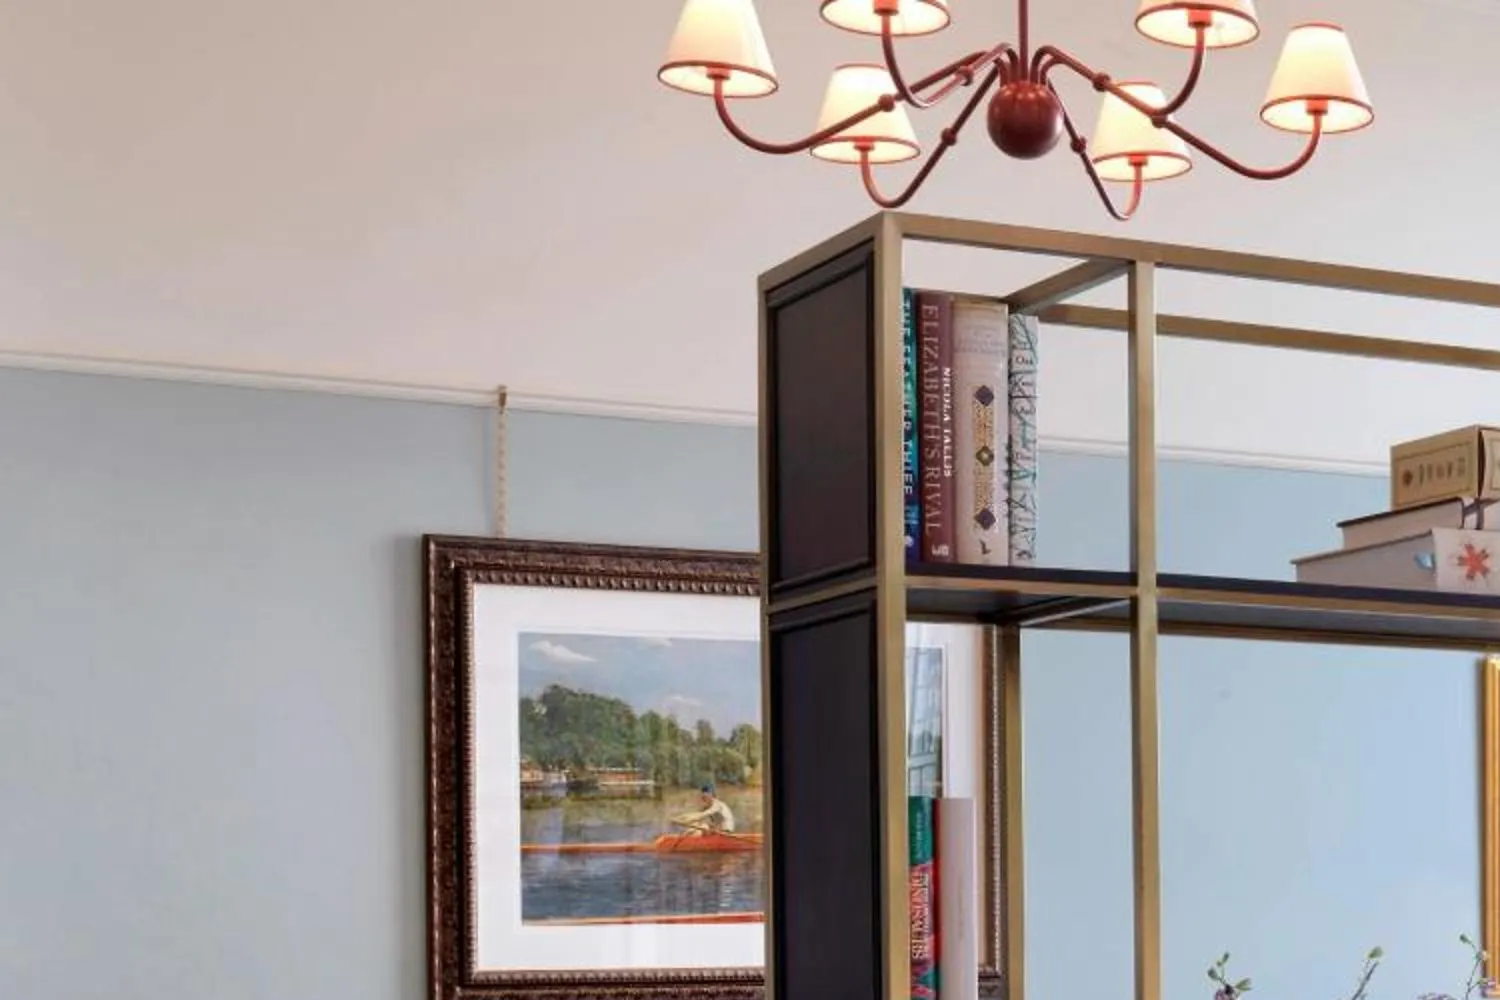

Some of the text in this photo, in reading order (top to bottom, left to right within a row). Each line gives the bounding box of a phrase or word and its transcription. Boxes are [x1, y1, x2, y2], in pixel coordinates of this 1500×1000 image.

[922, 304, 942, 460] ELIZABETH'S
[904, 440, 913, 495] THIEF
[943, 429, 952, 478] TALLIS
[924, 466, 942, 536] RIVAL
